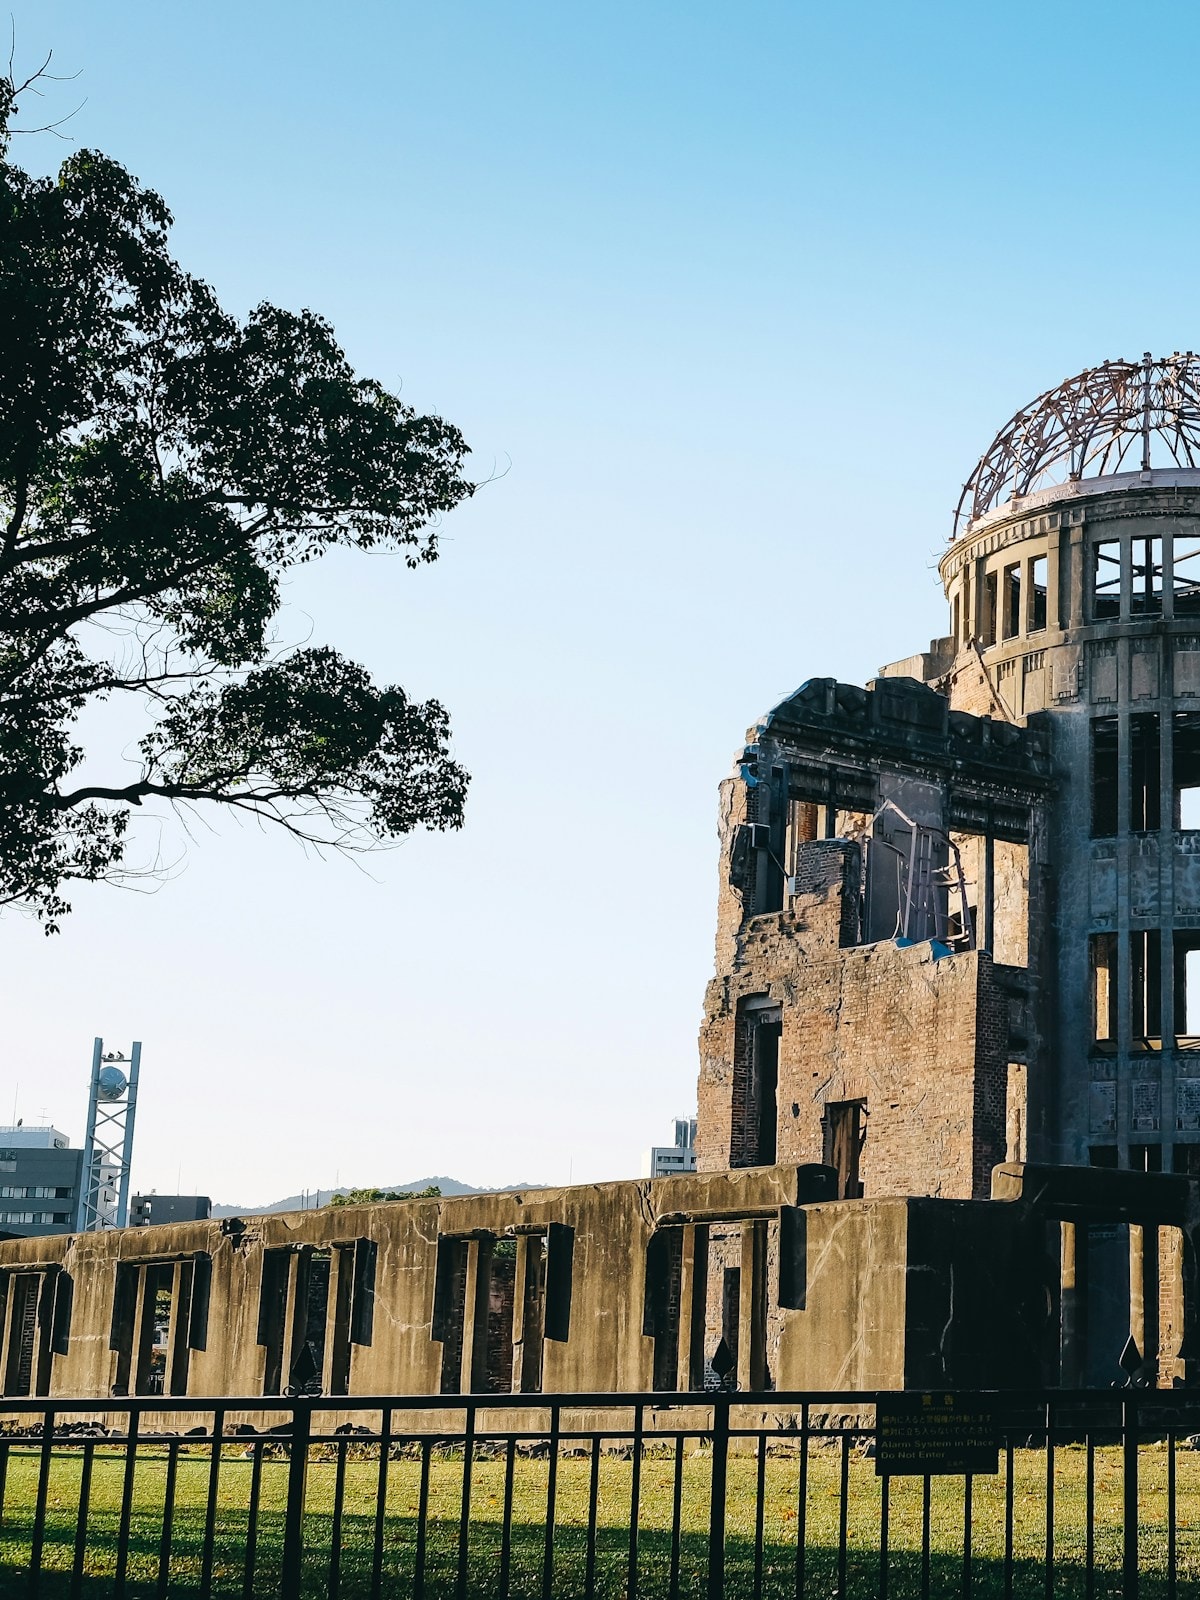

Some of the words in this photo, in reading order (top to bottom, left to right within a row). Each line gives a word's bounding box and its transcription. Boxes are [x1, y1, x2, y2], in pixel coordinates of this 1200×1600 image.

[881, 1440, 911, 1448] Alarm
[914, 1440, 952, 1449] System
[967, 1438, 995, 1447] Place
[881, 1451, 895, 1459] Do
[898, 1450, 916, 1459] Not
[918, 1450, 946, 1459] Enter
